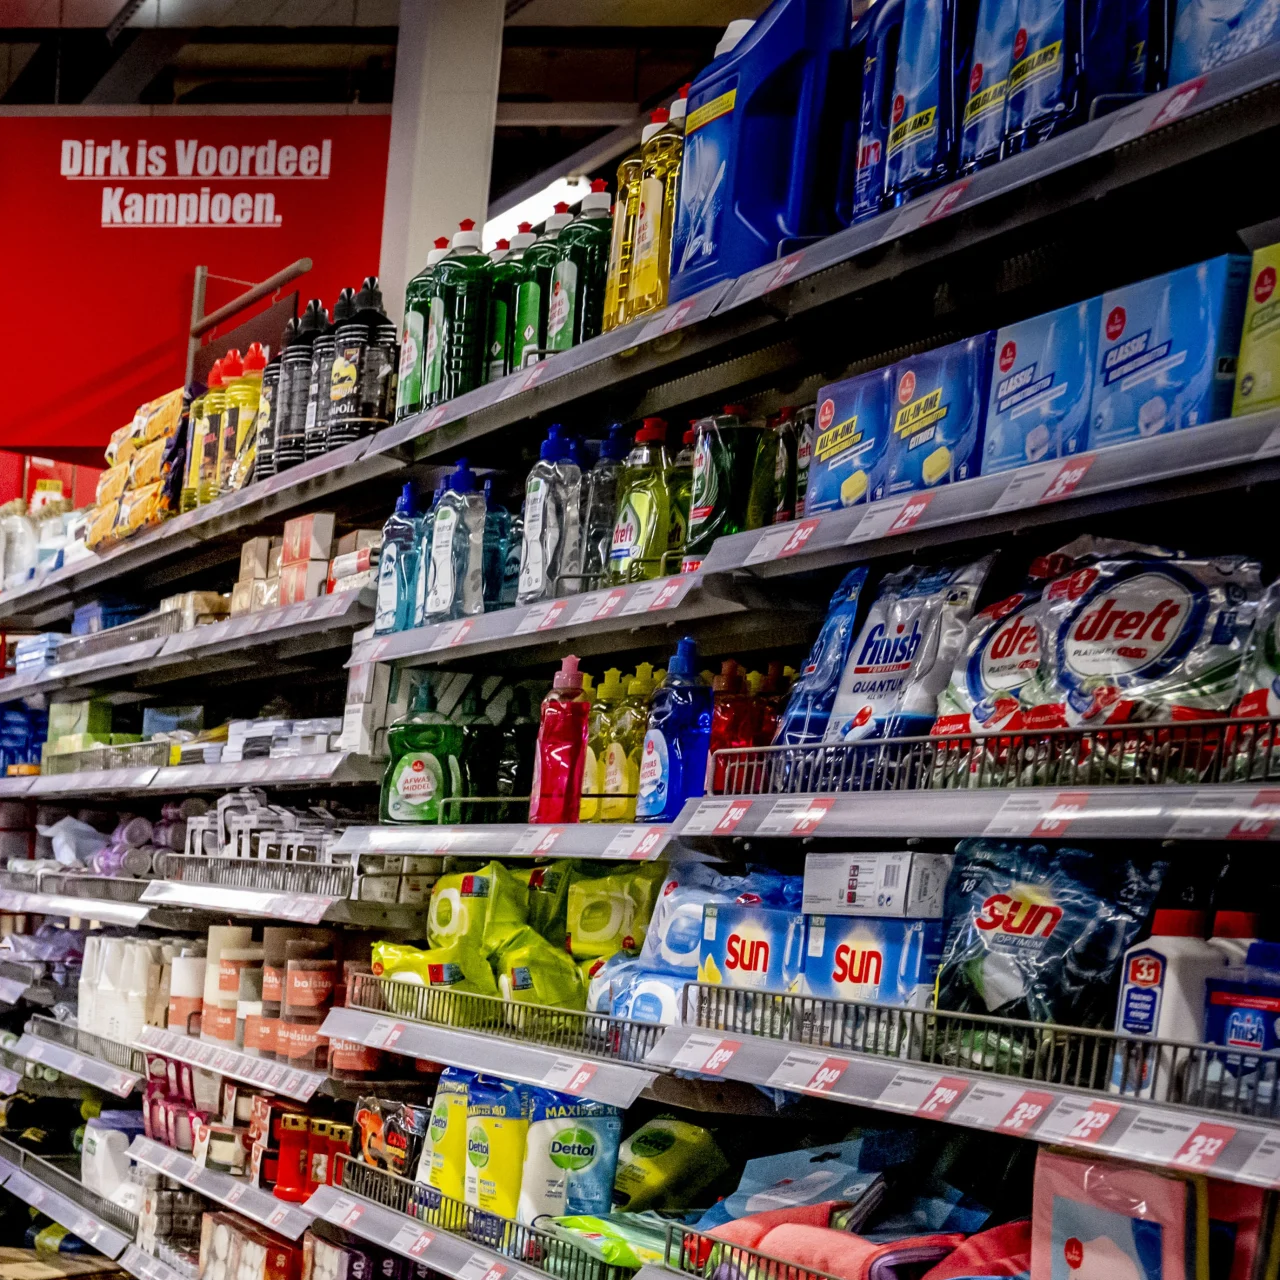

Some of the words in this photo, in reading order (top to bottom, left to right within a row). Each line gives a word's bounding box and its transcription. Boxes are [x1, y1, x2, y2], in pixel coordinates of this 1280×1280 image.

[61, 140, 129, 177] Dirk
[137, 140, 166, 177] is
[175, 139, 332, 177] Voordeel
[101, 187, 283, 227] Kampioen.
[1106, 333, 1147, 368] CLASSIC
[998, 365, 1035, 398] CLASSIC
[899, 393, 940, 427] ALL-IN-ONE
[1073, 598, 1182, 644] dreft
[856, 619, 923, 667] finish
[402, 782, 431, 792] MIDDEL
[403, 776, 431, 786] AFWAS
[995, 934, 1044, 949] OPTIMUM
[293, 976, 332, 989] bolsius
[811, 1065, 841, 1090] 9.49
[545, 1106, 581, 1119] MAXI
[923, 1086, 958, 1113] 7.98
[432, 1115, 448, 1130] Dettol
[1004, 1102, 1043, 1129] 3.59
[1073, 1110, 1111, 1137] 2.29
[468, 1139, 489, 1156] Dettol
[551, 1142, 597, 1157] Dettol
